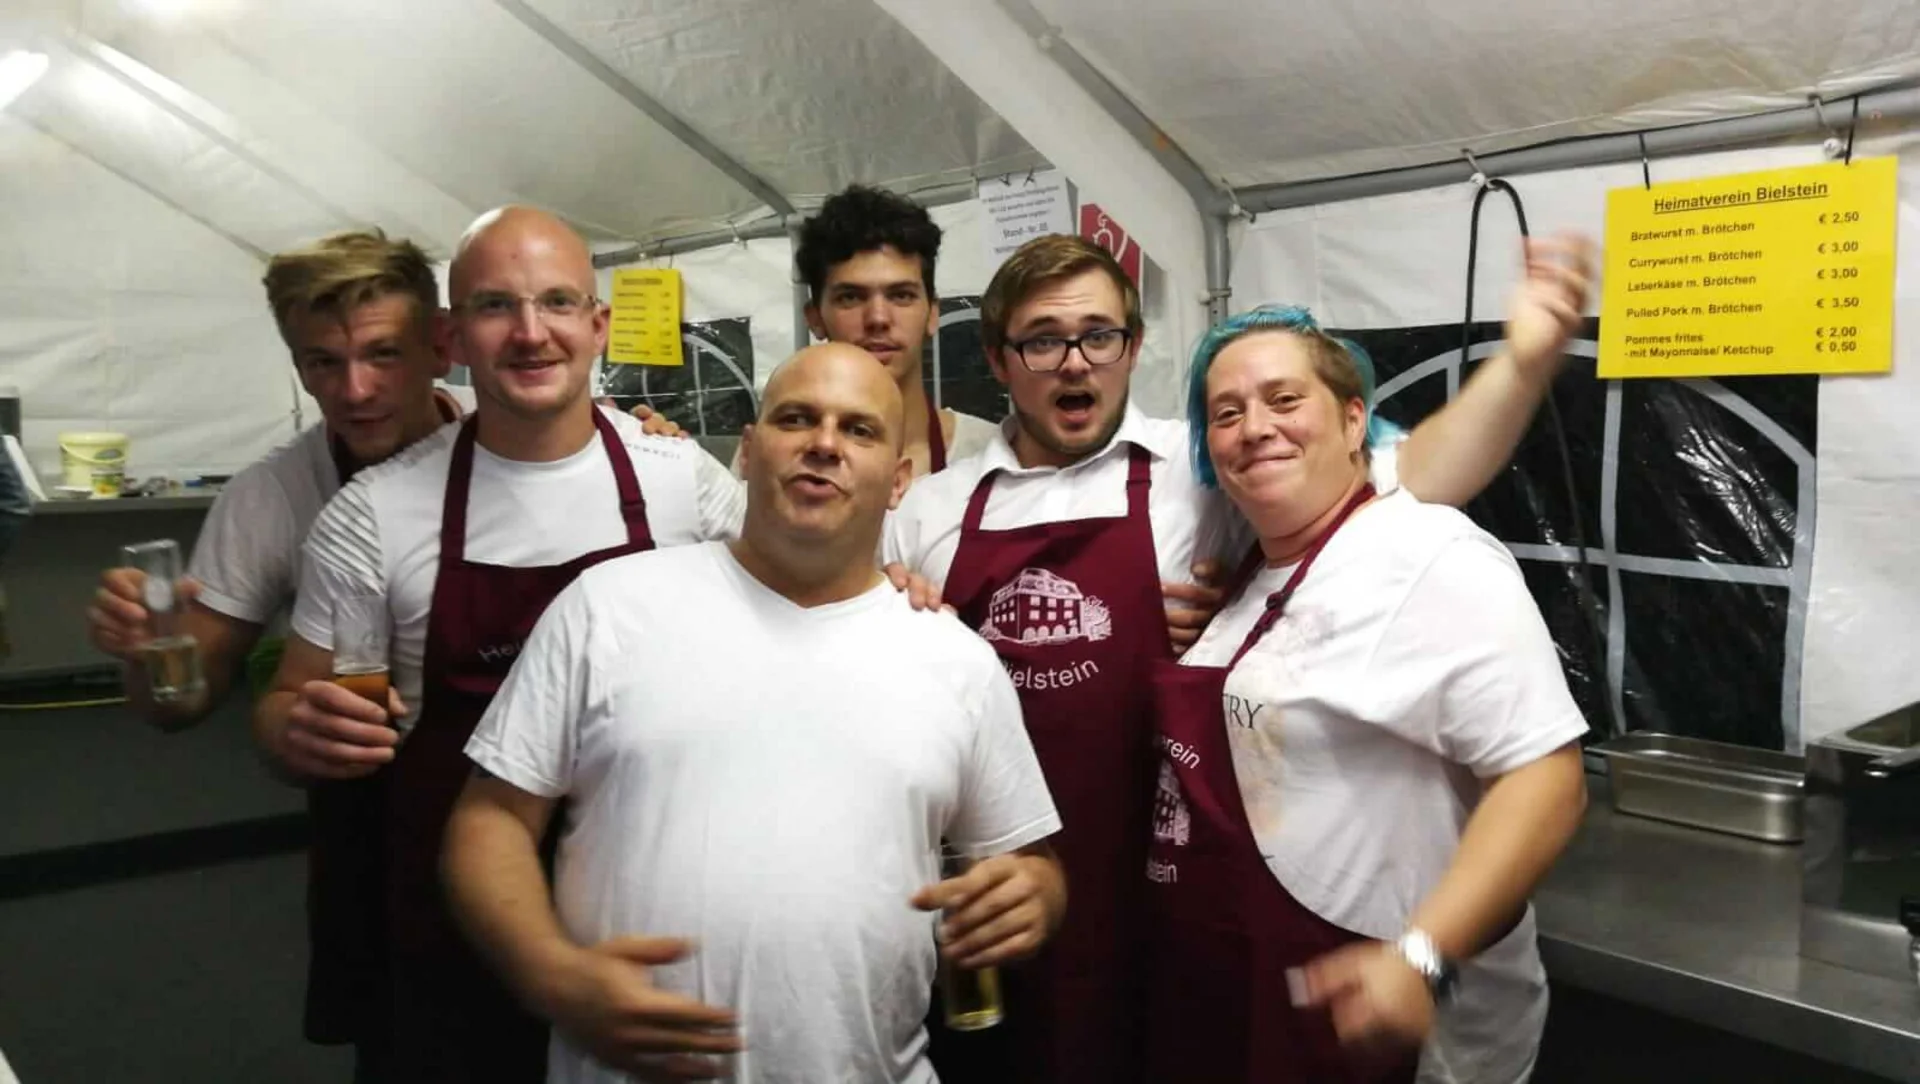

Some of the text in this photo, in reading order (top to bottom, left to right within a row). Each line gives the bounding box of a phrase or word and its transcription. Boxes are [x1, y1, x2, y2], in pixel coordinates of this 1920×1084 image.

[1653, 182, 1828, 212] Heimatverein Bielstein
[1631, 228, 1682, 241] Bratwurst
[1686, 227, 1699, 236] m.
[1702, 221, 1755, 235] Brötchen
[1629, 255, 1689, 269] Currywurst
[1691, 254, 1704, 263] m.
[1708, 250, 1762, 262] Brötchen
[1628, 278, 1683, 292] Leberkäse
[1686, 279, 1699, 288] m.
[1703, 275, 1756, 287] Brötchen
[1626, 307, 1660, 318] Pulled
[1662, 306, 1688, 316] Pork
[1691, 306, 1704, 315] m.
[1708, 302, 1763, 314] Brötchen
[1625, 334, 1671, 345] Pommes
[1675, 332, 1704, 343] frites
[1723, 345, 1774, 357] Ketchup
[1222, 692, 1263, 730] RY
